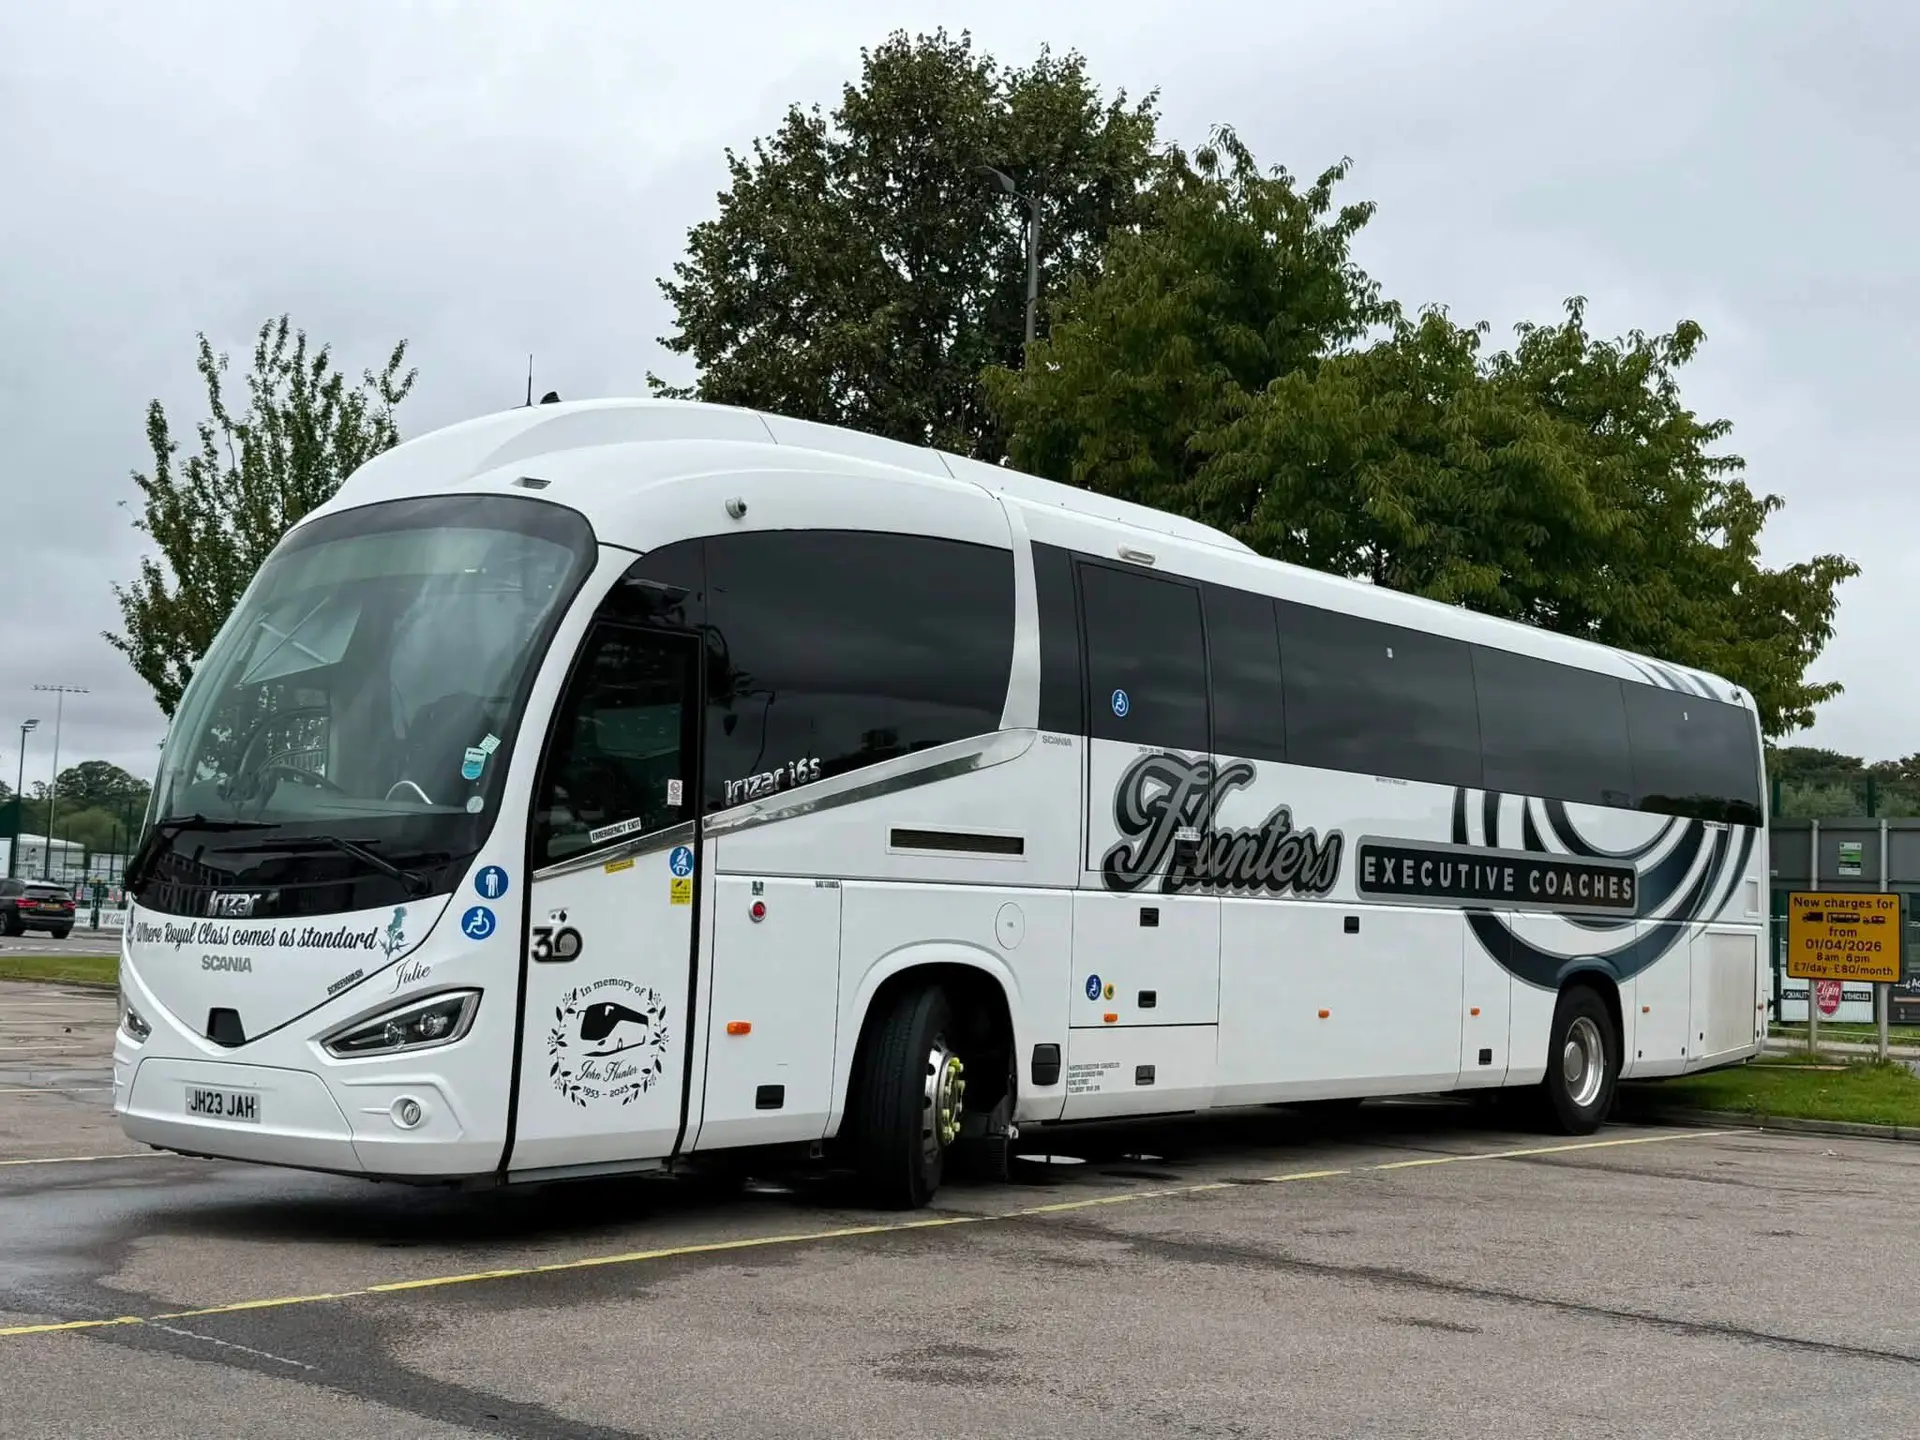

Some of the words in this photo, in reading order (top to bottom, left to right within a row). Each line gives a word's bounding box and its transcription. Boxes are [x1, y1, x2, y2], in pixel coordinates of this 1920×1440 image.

[724, 768, 784, 806] Irizar
[788, 757, 821, 788] i6s
[1103, 752, 1343, 896] Hunters
[1364, 855, 1514, 893] EXECUTIVE
[1529, 869, 1632, 901] COACHES
[1794, 897, 1820, 908] New
[1824, 899, 1872, 910] charges
[1876, 898, 1895, 910] for
[136, 922, 163, 942] Where
[164, 921, 196, 952] Royal
[199, 921, 231, 946] Class
[232, 926, 277, 947] comes
[278, 928, 297, 947] as
[297, 924, 380, 951] standard
[1829, 926, 1857, 937] from
[1805, 938, 1882, 952] 01/04/2026
[201, 954, 253, 974] SCANIA
[389, 959, 431, 995] Julie
[580, 986, 592, 997] In
[593, 978, 634, 991] memory
[634, 987, 647, 996] of
[575, 1059, 601, 1081] John
[603, 1060, 638, 1082] Hunter
[583, 1086, 600, 1098] 1953
[609, 1085, 630, 1097] 2023
[191, 1090, 223, 1114] JH23
[227, 1094, 254, 1118] JAH
